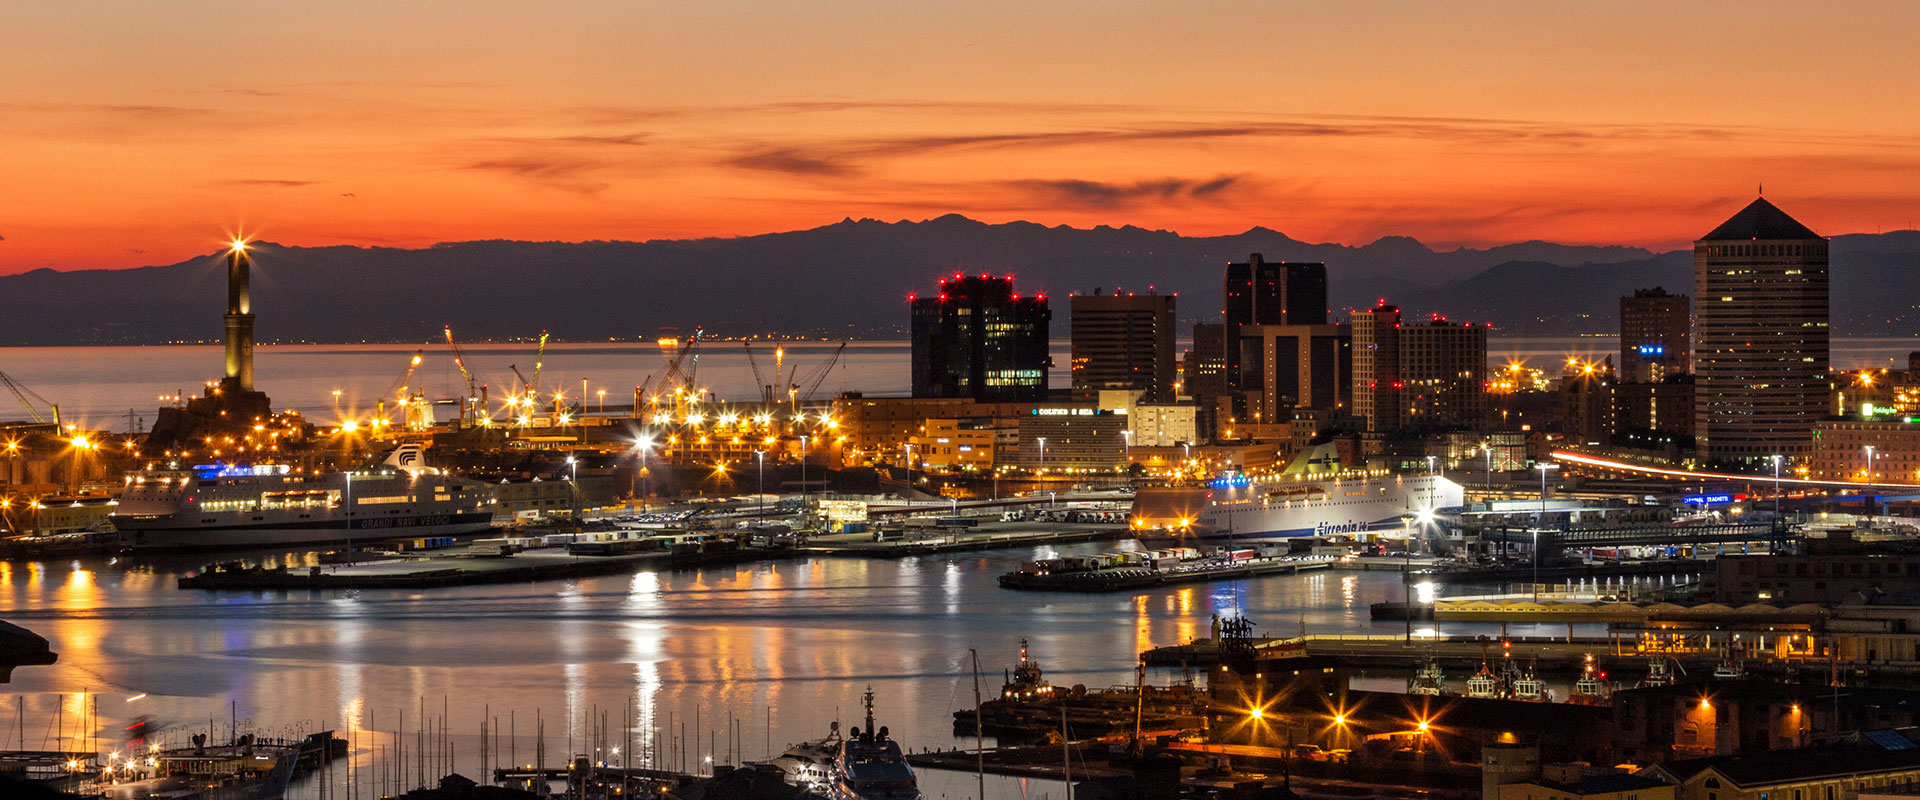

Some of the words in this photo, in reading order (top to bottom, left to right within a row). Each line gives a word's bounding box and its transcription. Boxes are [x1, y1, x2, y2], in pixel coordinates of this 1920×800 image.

[361, 519, 393, 529] GRANDI
[397, 518, 416, 527] NAVI
[420, 516, 450, 526] VELOCI
